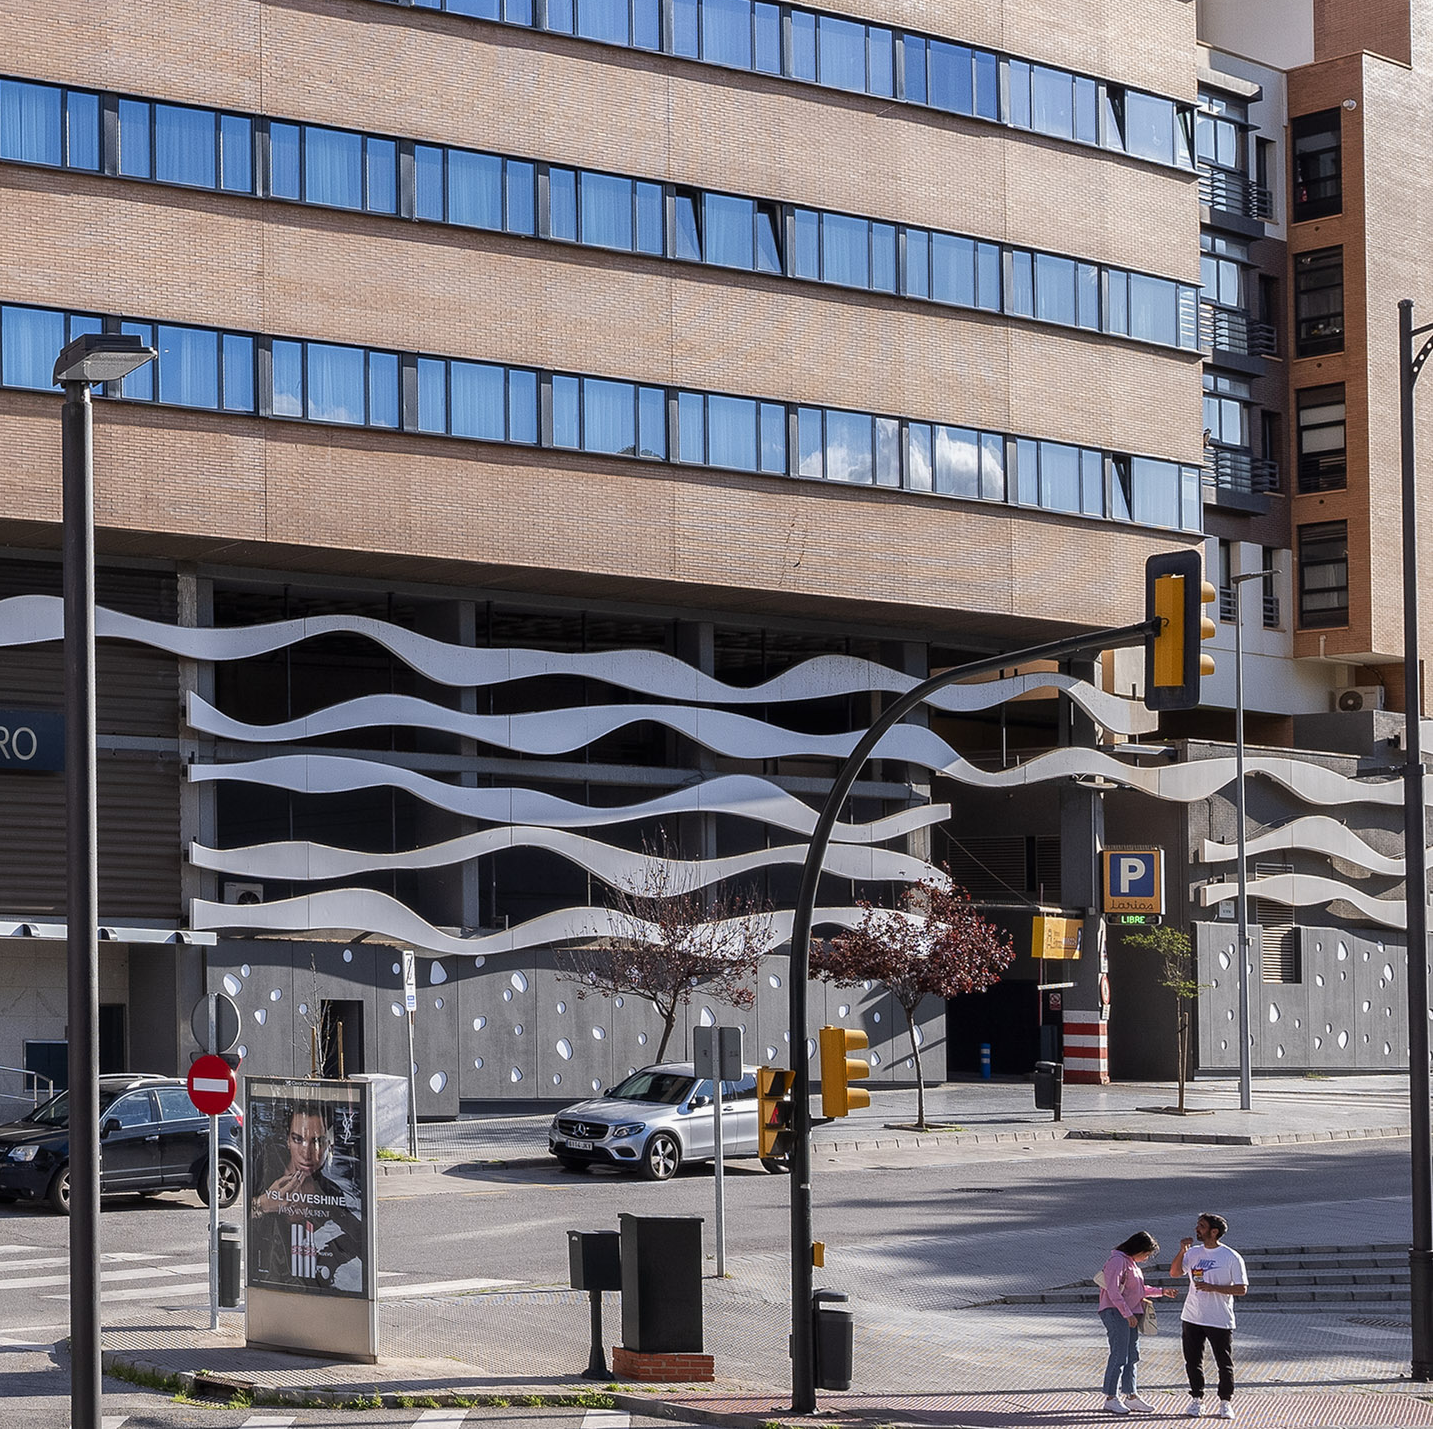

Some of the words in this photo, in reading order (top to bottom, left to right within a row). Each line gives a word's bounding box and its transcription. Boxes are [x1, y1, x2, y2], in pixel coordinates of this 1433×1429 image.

[1120, 857, 1146, 893] P
[1121, 915, 1146, 924] LIBRE
[265, 1190, 283, 1201] YSL
[286, 1192, 346, 1207] LOVESHINE
